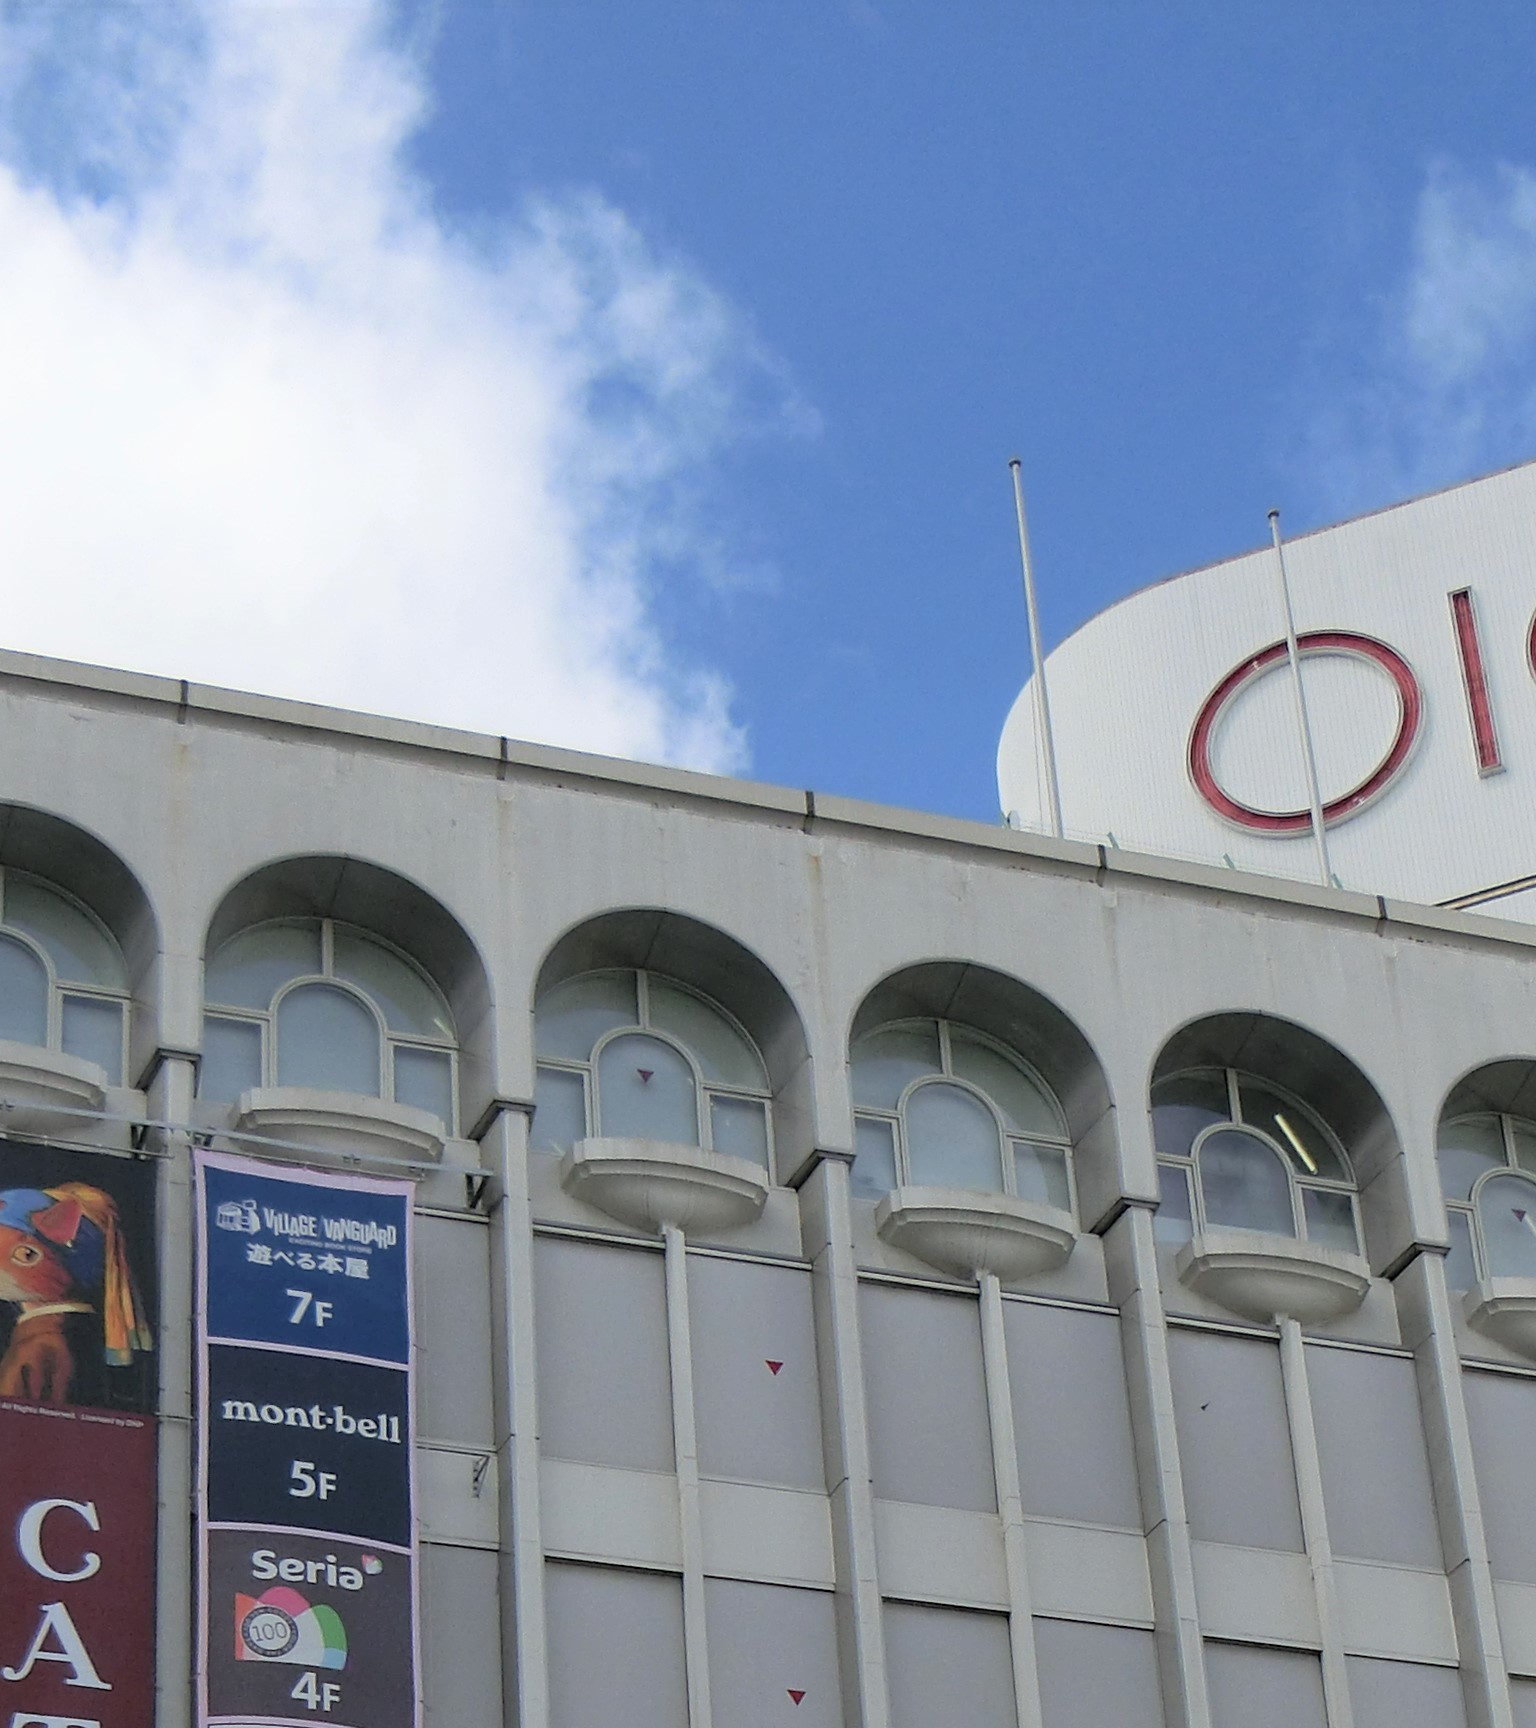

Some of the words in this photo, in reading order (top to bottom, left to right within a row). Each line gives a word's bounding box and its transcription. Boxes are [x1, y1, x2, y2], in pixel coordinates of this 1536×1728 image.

[263, 1207, 318, 1237] VILLAGE
[323, 1217, 397, 1249] VANGUARD
[246, 1243, 370, 1279] 遊べる本屋
[286, 1288, 333, 1328] 7F
[289, 1461, 338, 1500] 5F
[251, 1549, 364, 1591] Seria
[252, 1621, 288, 1642] 100
[291, 1671, 341, 1712] 4F
